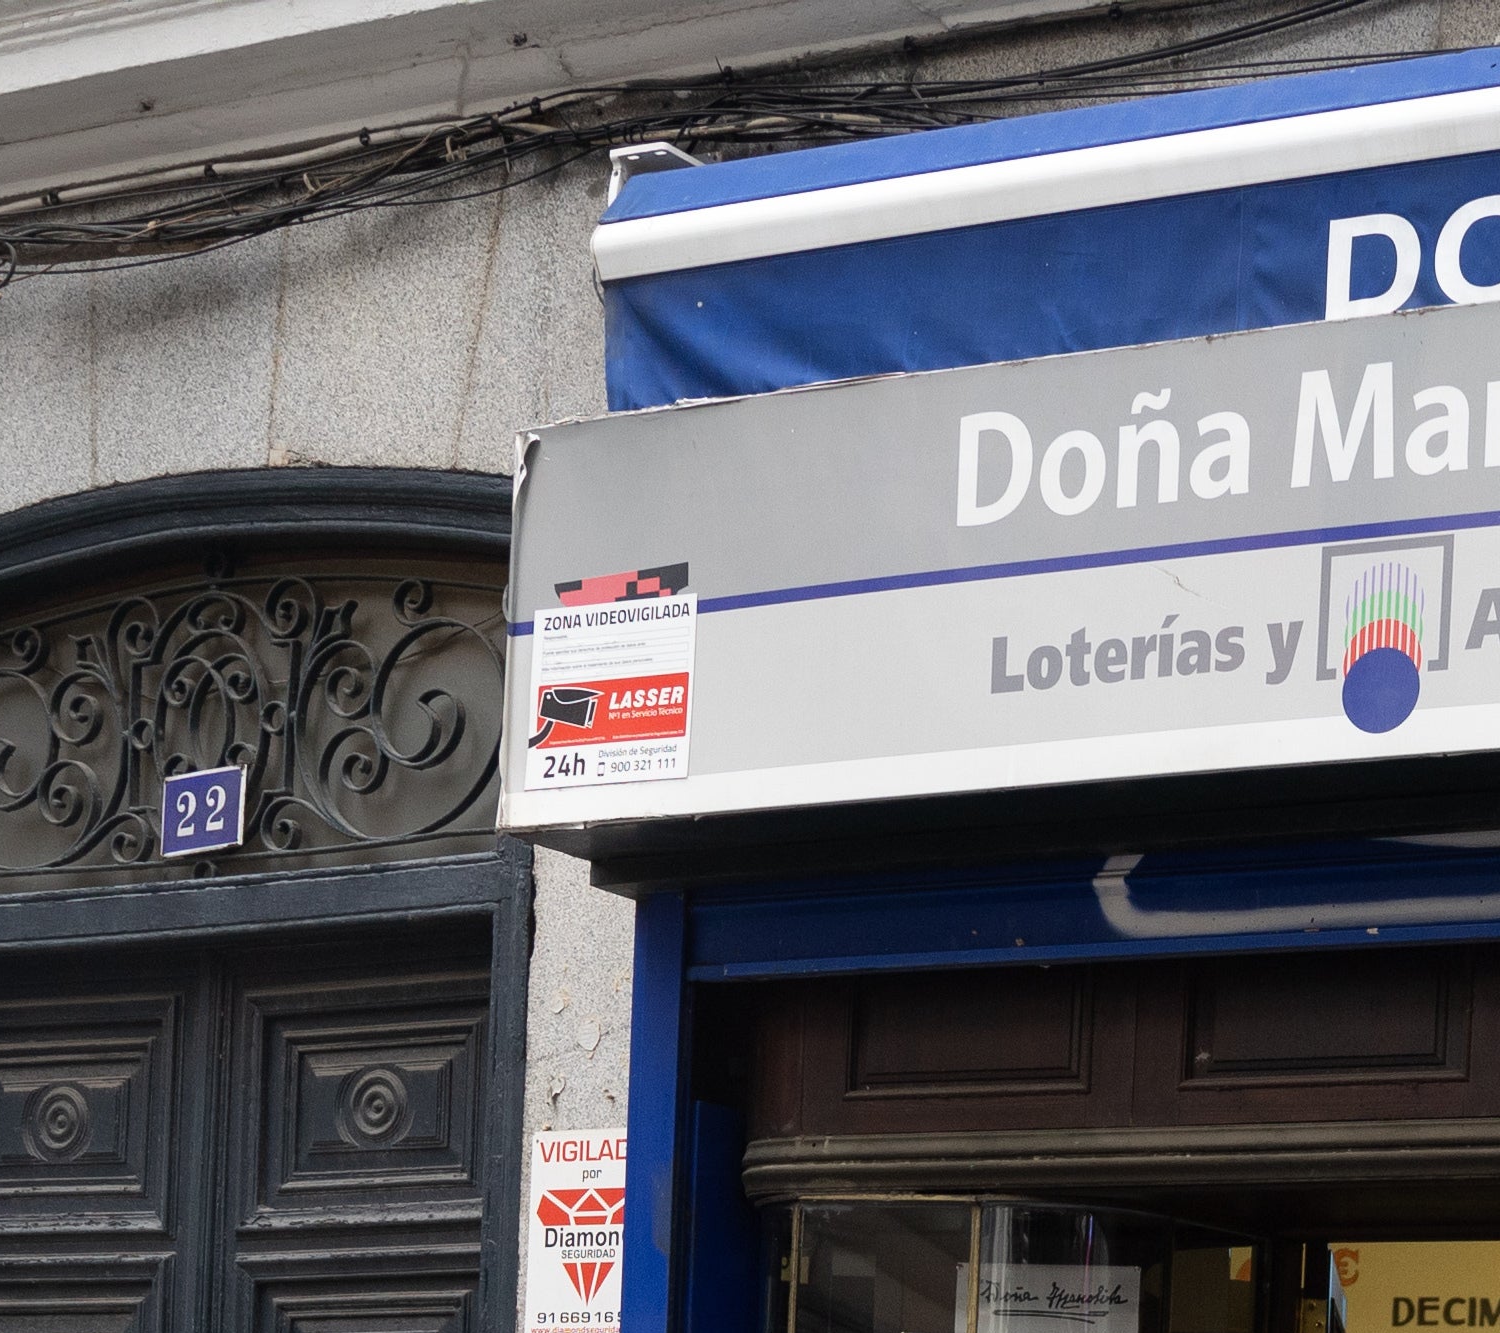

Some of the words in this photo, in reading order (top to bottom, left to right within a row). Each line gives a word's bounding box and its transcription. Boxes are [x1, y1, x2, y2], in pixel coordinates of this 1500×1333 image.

[955, 387, 1250, 527] Doña
[544, 614, 582, 632] ZONA
[585, 602, 691, 628] VIDEOVIGILADA
[989, 613, 1246, 694] Loterías
[1264, 618, 1305, 686] y
[608, 685, 685, 711] LASSER
[631, 708, 658, 719] Servicio
[658, 706, 684, 716] Técnico
[598, 747, 627, 759] División
[628, 747, 638, 756] de
[639, 744, 678, 757] Seguridad
[543, 752, 586, 779] 24h
[610, 760, 631, 773] 900
[633, 759, 651, 772] 321
[658, 757, 676, 769] 111
[176, 785, 227, 838] 22
[582, 1169, 603, 1183] por
[544, 1227, 624, 1249] Diamon
[561, 1248, 616, 1260] SEGURIDAD
[537, 1312, 557, 1325] 91
[559, 1312, 592, 1325] 669
